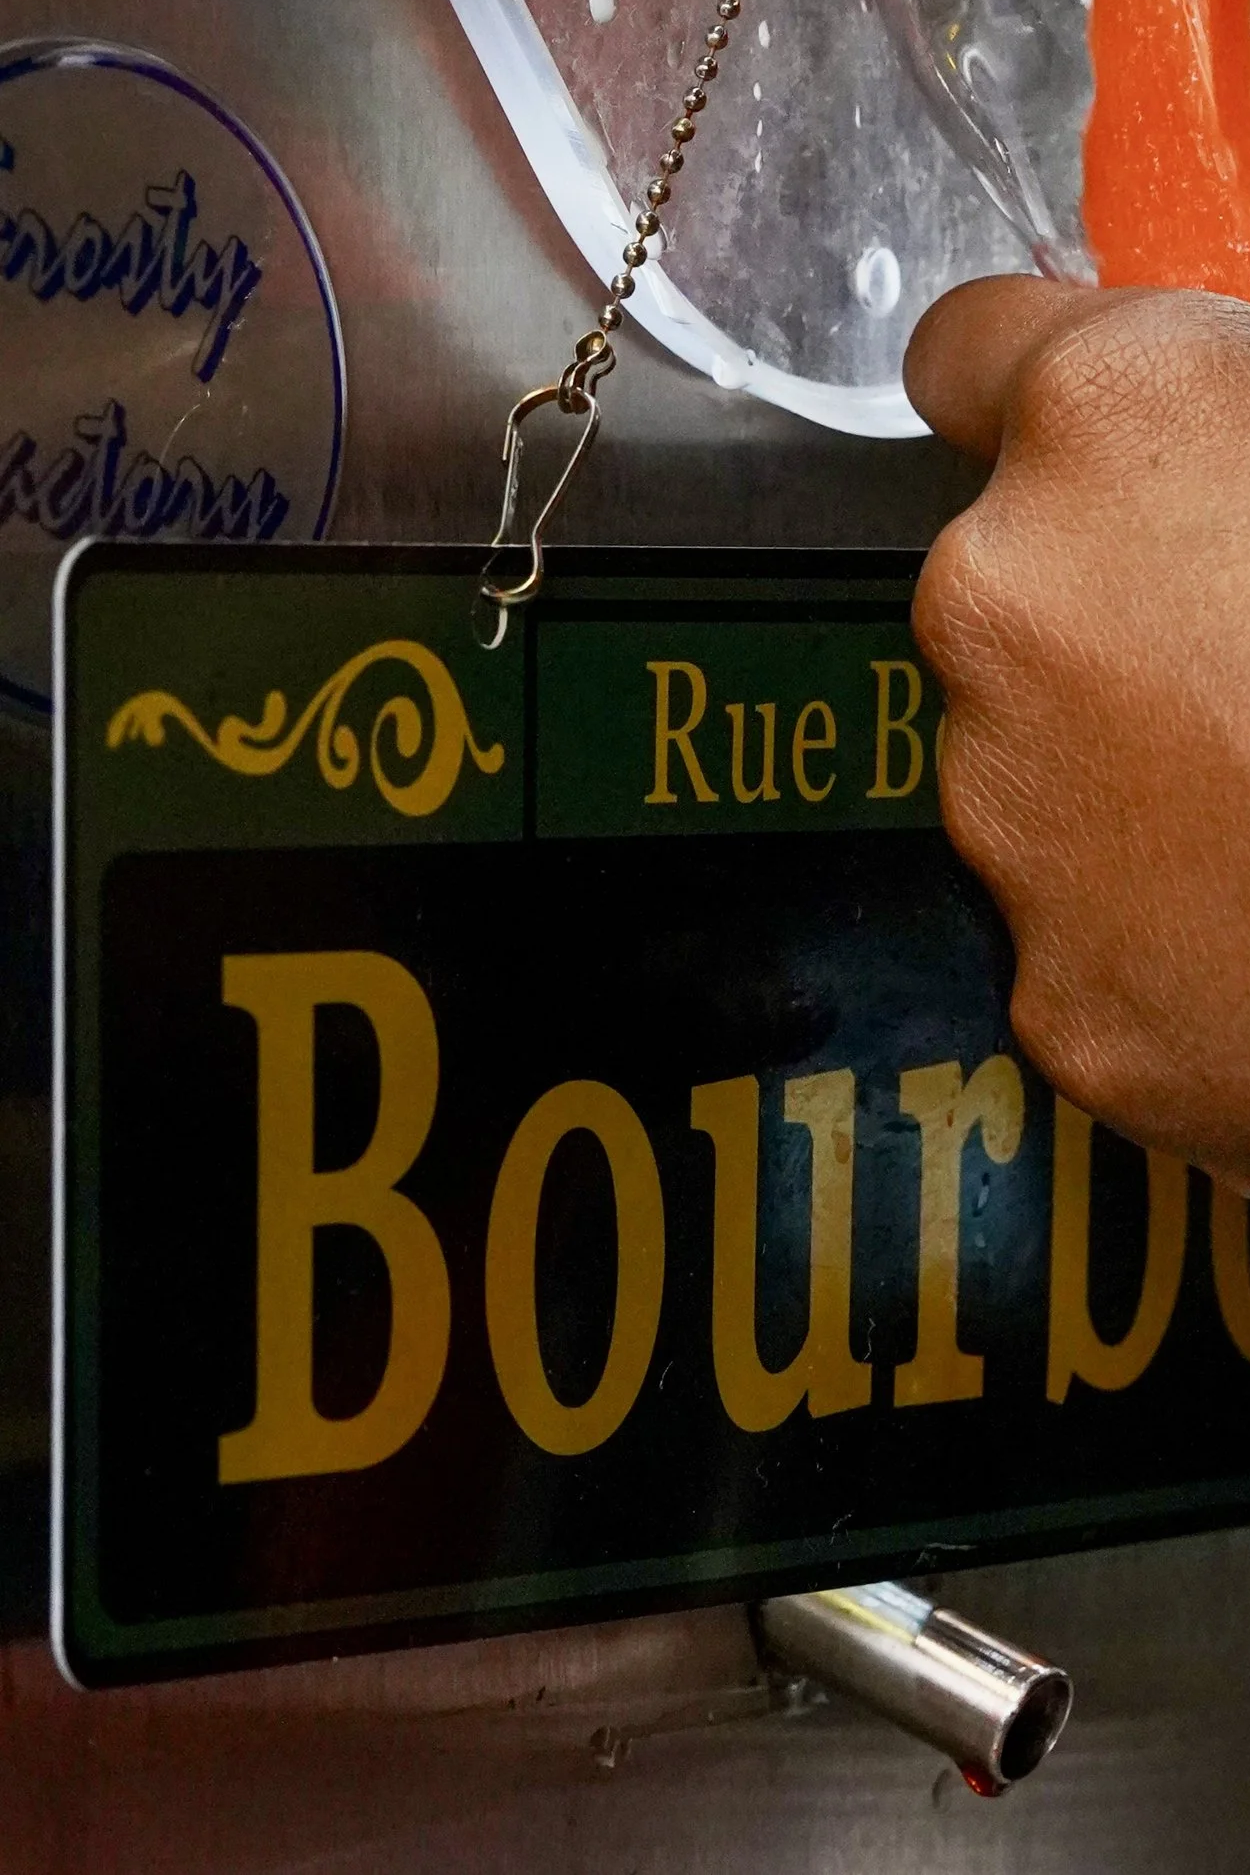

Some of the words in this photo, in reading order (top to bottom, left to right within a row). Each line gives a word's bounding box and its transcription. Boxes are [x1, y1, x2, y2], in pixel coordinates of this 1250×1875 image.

[0, 137, 261, 383] rosty
[644, 661, 837, 804] Rue
[865, 660, 945, 798] B
